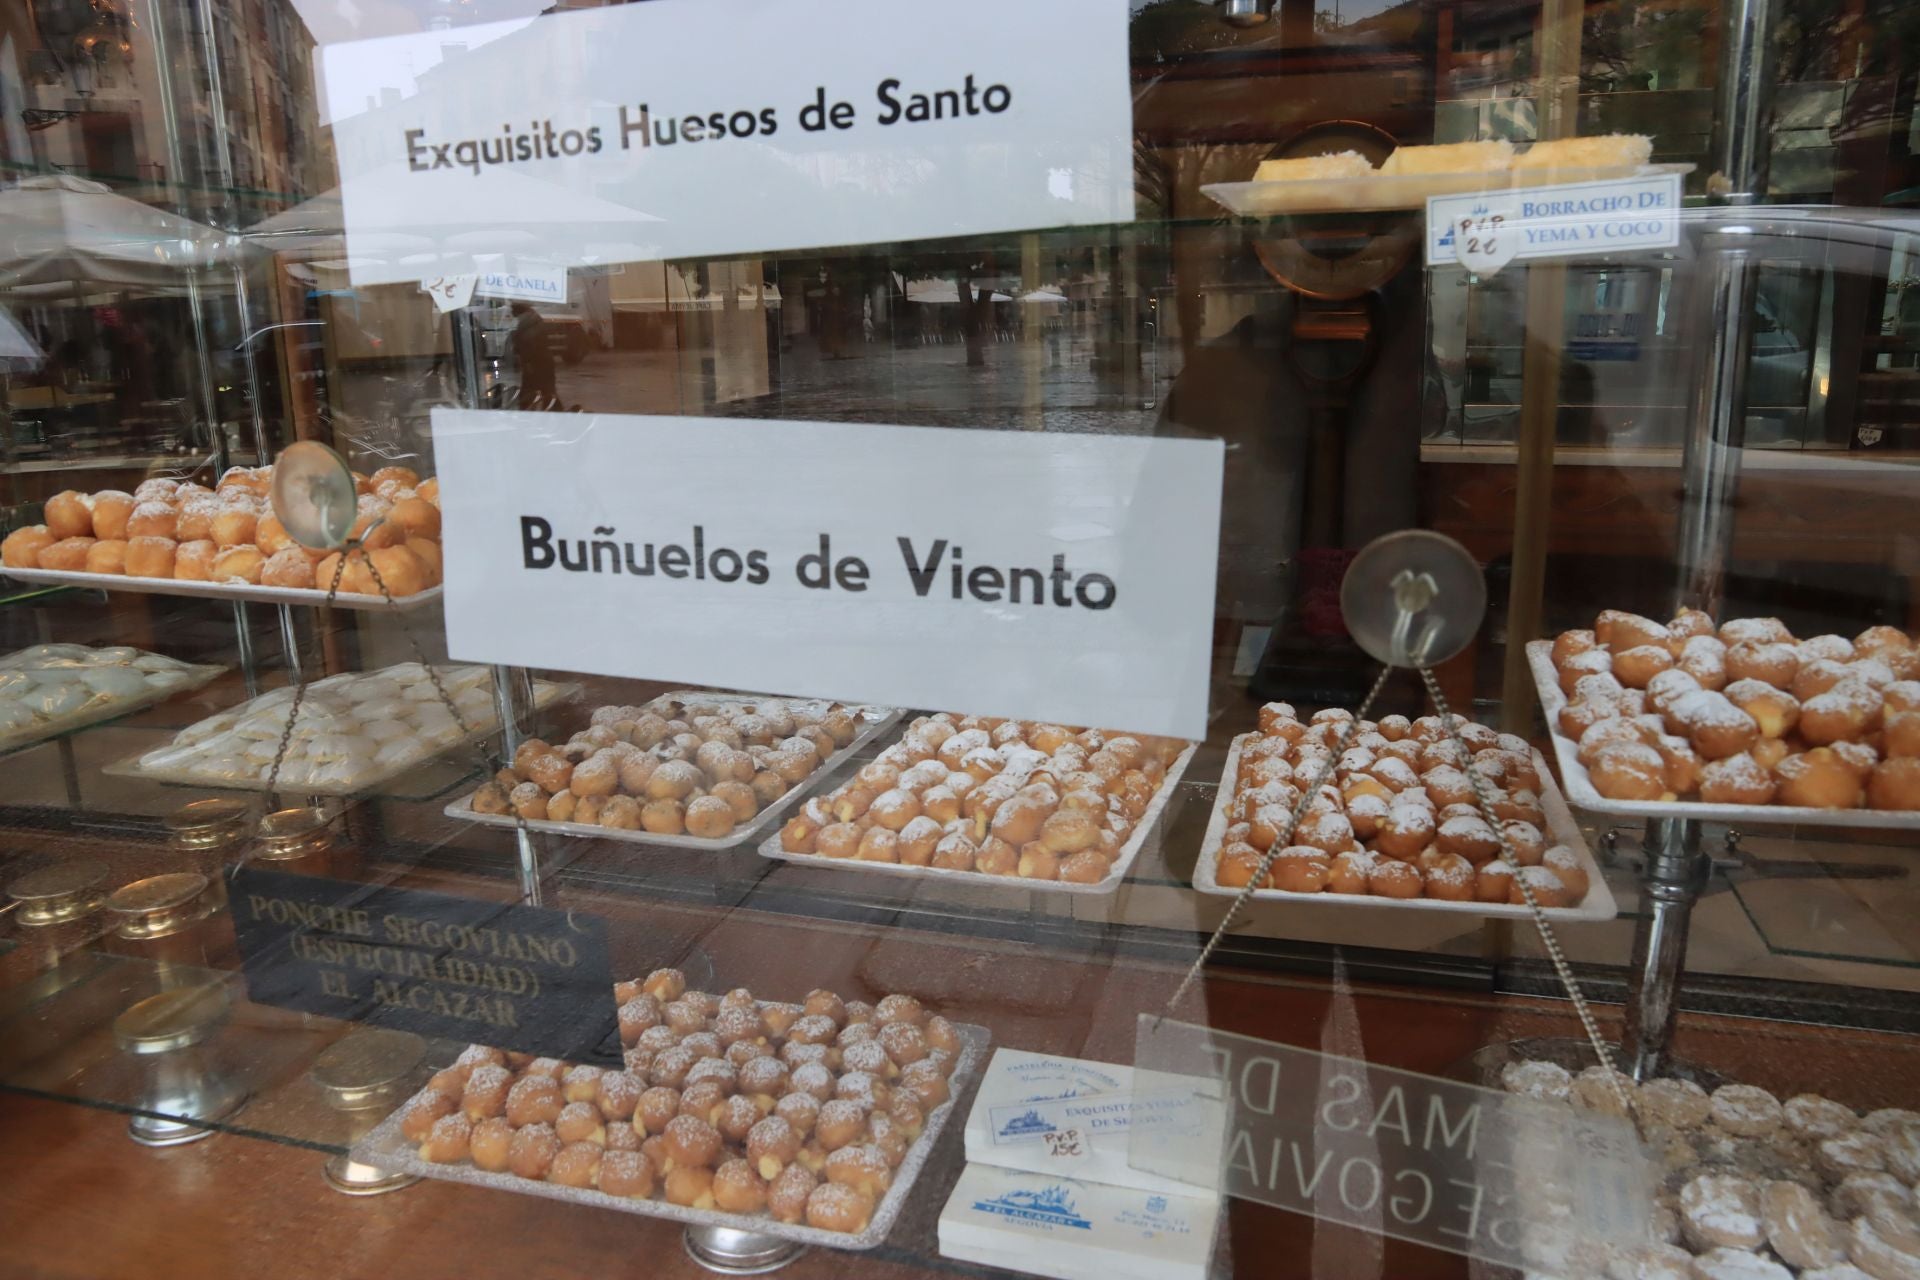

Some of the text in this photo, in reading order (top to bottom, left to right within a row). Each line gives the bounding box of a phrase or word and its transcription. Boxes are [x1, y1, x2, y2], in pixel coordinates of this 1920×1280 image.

[405, 74, 1011, 176] Exquisitos Huesos de Santo
[1523, 195, 1632, 218] BORRACHO
[1525, 220, 1663, 243] YEMA Y COCO
[506, 275, 557, 292] CANELA
[520, 516, 1116, 610] Buñuelos de Viento
[249, 895, 578, 968] PONCHE SEGOVIANO
[291, 932, 540, 998] (ESPECIALIDAD)
[373, 979, 518, 1028] ALCAZAR
